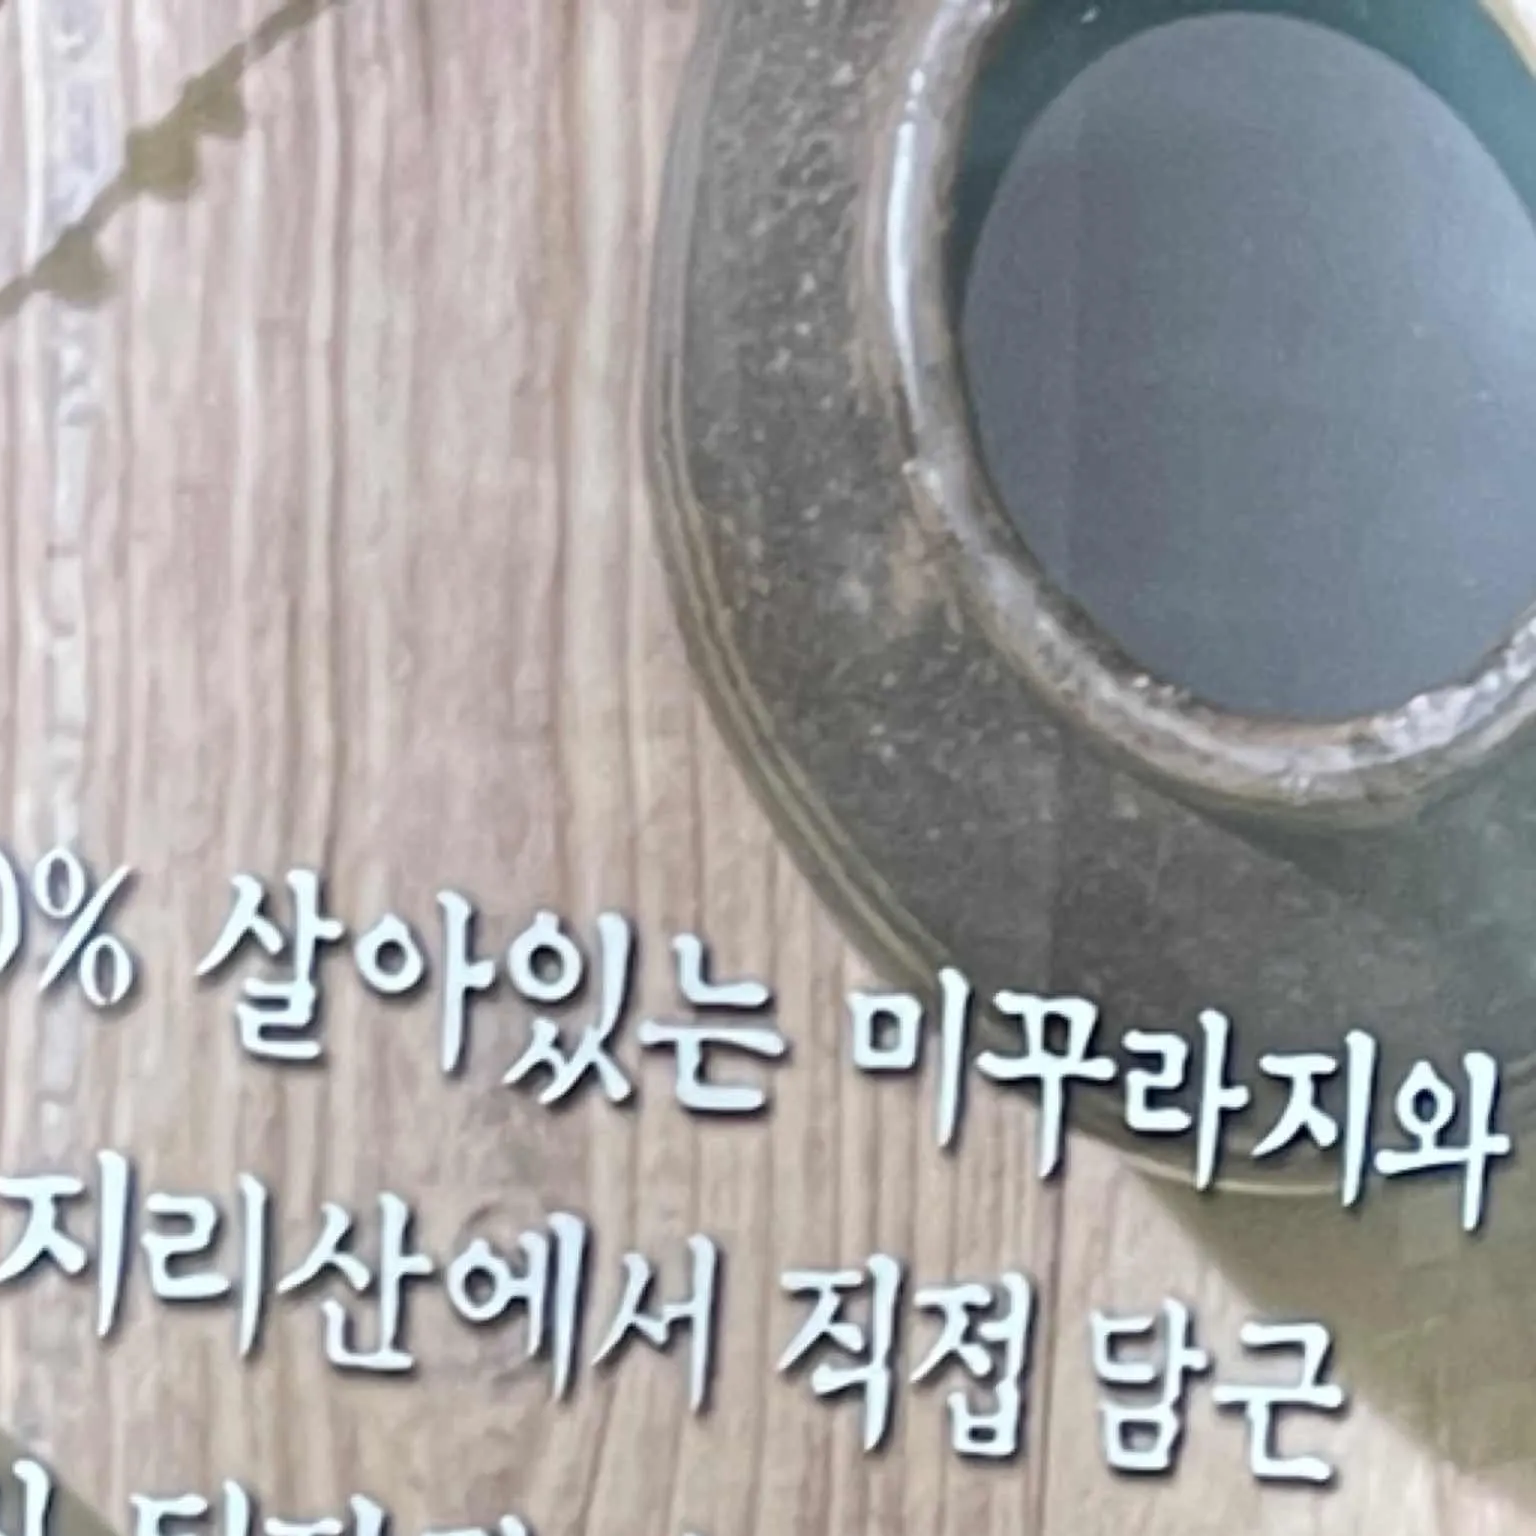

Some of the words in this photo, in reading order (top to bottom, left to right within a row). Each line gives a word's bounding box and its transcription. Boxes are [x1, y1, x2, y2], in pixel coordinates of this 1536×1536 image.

[194, 867, 786, 1110] 살아있는
[845, 966, 1511, 1231] 미꾸라지와
[775, 1251, 1031, 1456] 직접
[1087, 1294, 1344, 1481] 담근
